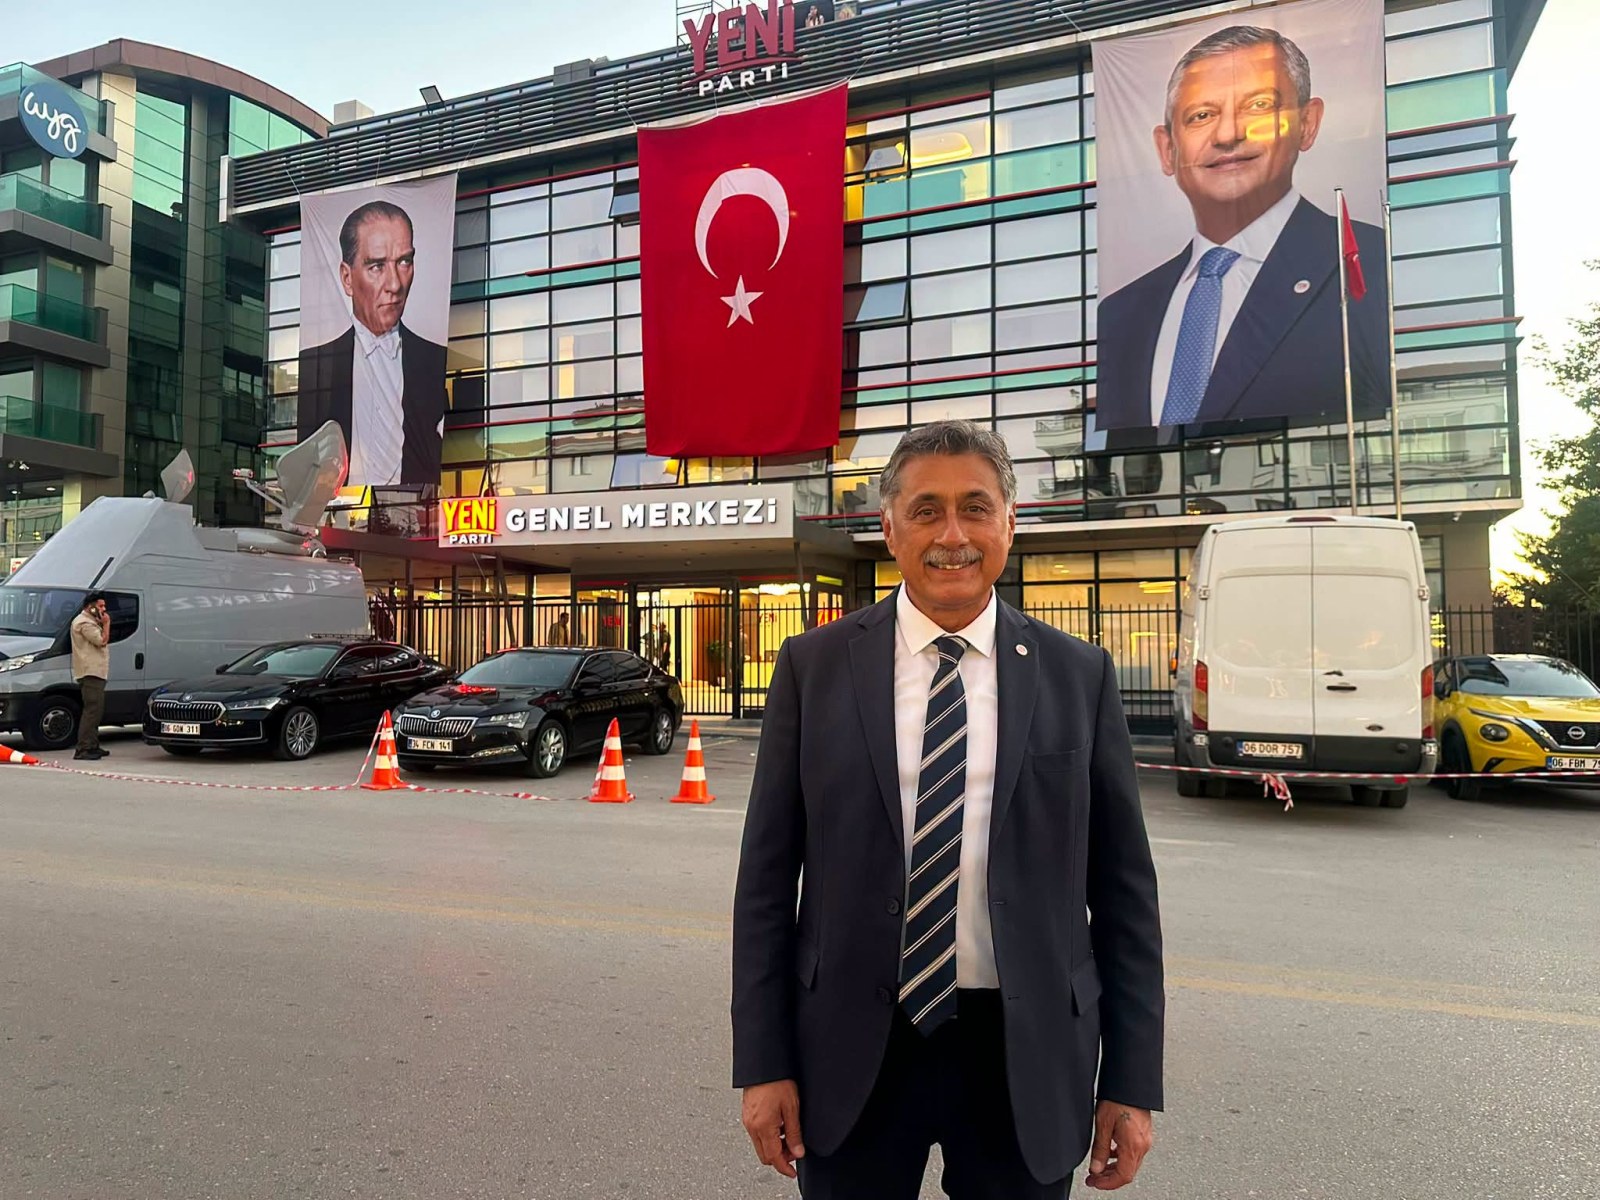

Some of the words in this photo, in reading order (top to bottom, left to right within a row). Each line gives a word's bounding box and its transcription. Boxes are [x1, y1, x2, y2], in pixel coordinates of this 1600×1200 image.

[505, 505, 612, 533] GENEL
[621, 497, 777, 529] MERKEZİ
[186, 725, 198, 734] 311
[439, 741, 450, 750] 141
[1243, 743, 1257, 753] 06
[1281, 744, 1301, 755] 757
[1552, 758, 1564, 767] 06
[1568, 758, 1586, 768] FBM
